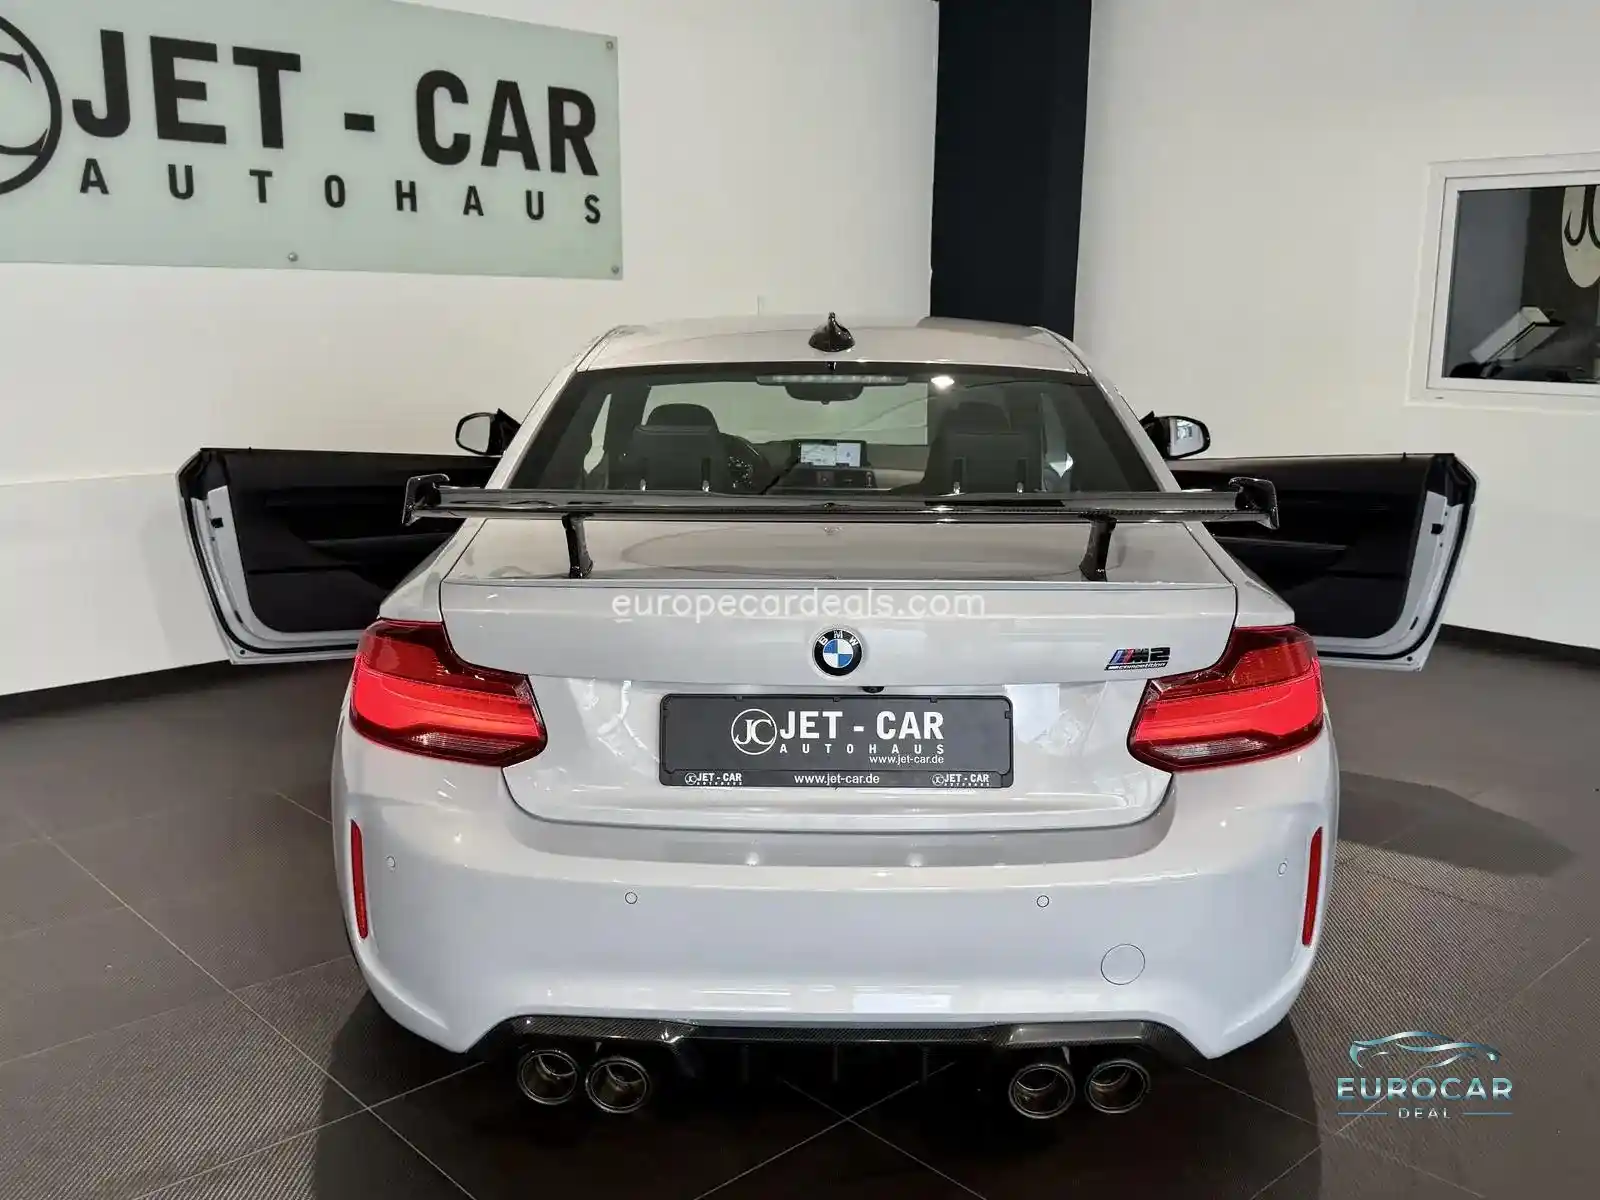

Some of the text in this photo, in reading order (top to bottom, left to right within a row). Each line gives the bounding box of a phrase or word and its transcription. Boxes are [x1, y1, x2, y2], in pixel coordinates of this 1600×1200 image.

[72, 29, 599, 176] JET - CAR
[80, 157, 601, 224] AUTOHAUS
[818, 630, 859, 646] BMW
[733, 718, 774, 746] JC
[780, 711, 843, 739] JET
[876, 711, 944, 739] CAR
[780, 744, 944, 754] AUTOHAUS
[869, 755, 944, 765] www.jet-car.de
[697, 773, 715, 781] JET
[723, 773, 742, 781] CAR
[794, 773, 880, 786] www.jet-car.de
[944, 774, 961, 783] JET
[970, 774, 989, 782] CAR
